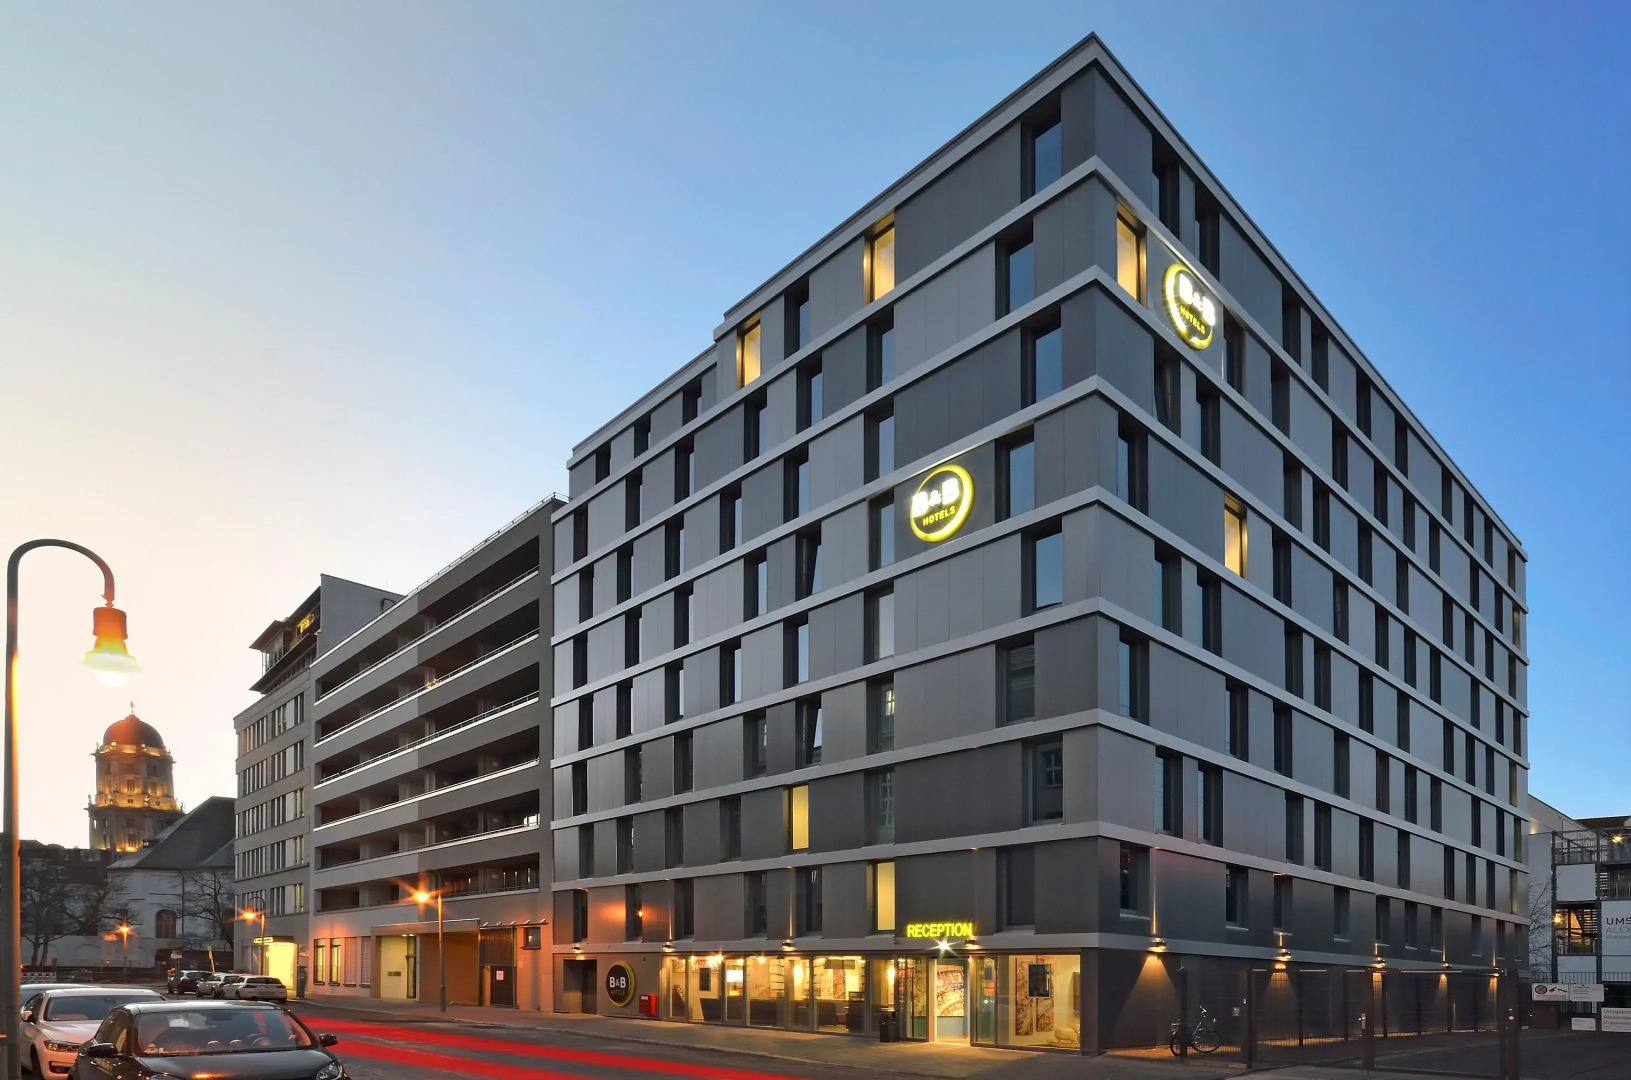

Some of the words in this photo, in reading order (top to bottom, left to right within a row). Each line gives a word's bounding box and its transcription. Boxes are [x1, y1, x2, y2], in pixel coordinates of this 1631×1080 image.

[1180, 305, 1206, 335] HOTELS
[912, 477, 960, 518] B&B
[922, 505, 956, 527] HOTELS
[907, 922, 973, 938] RECEPTION
[609, 976, 626, 988] B&B
